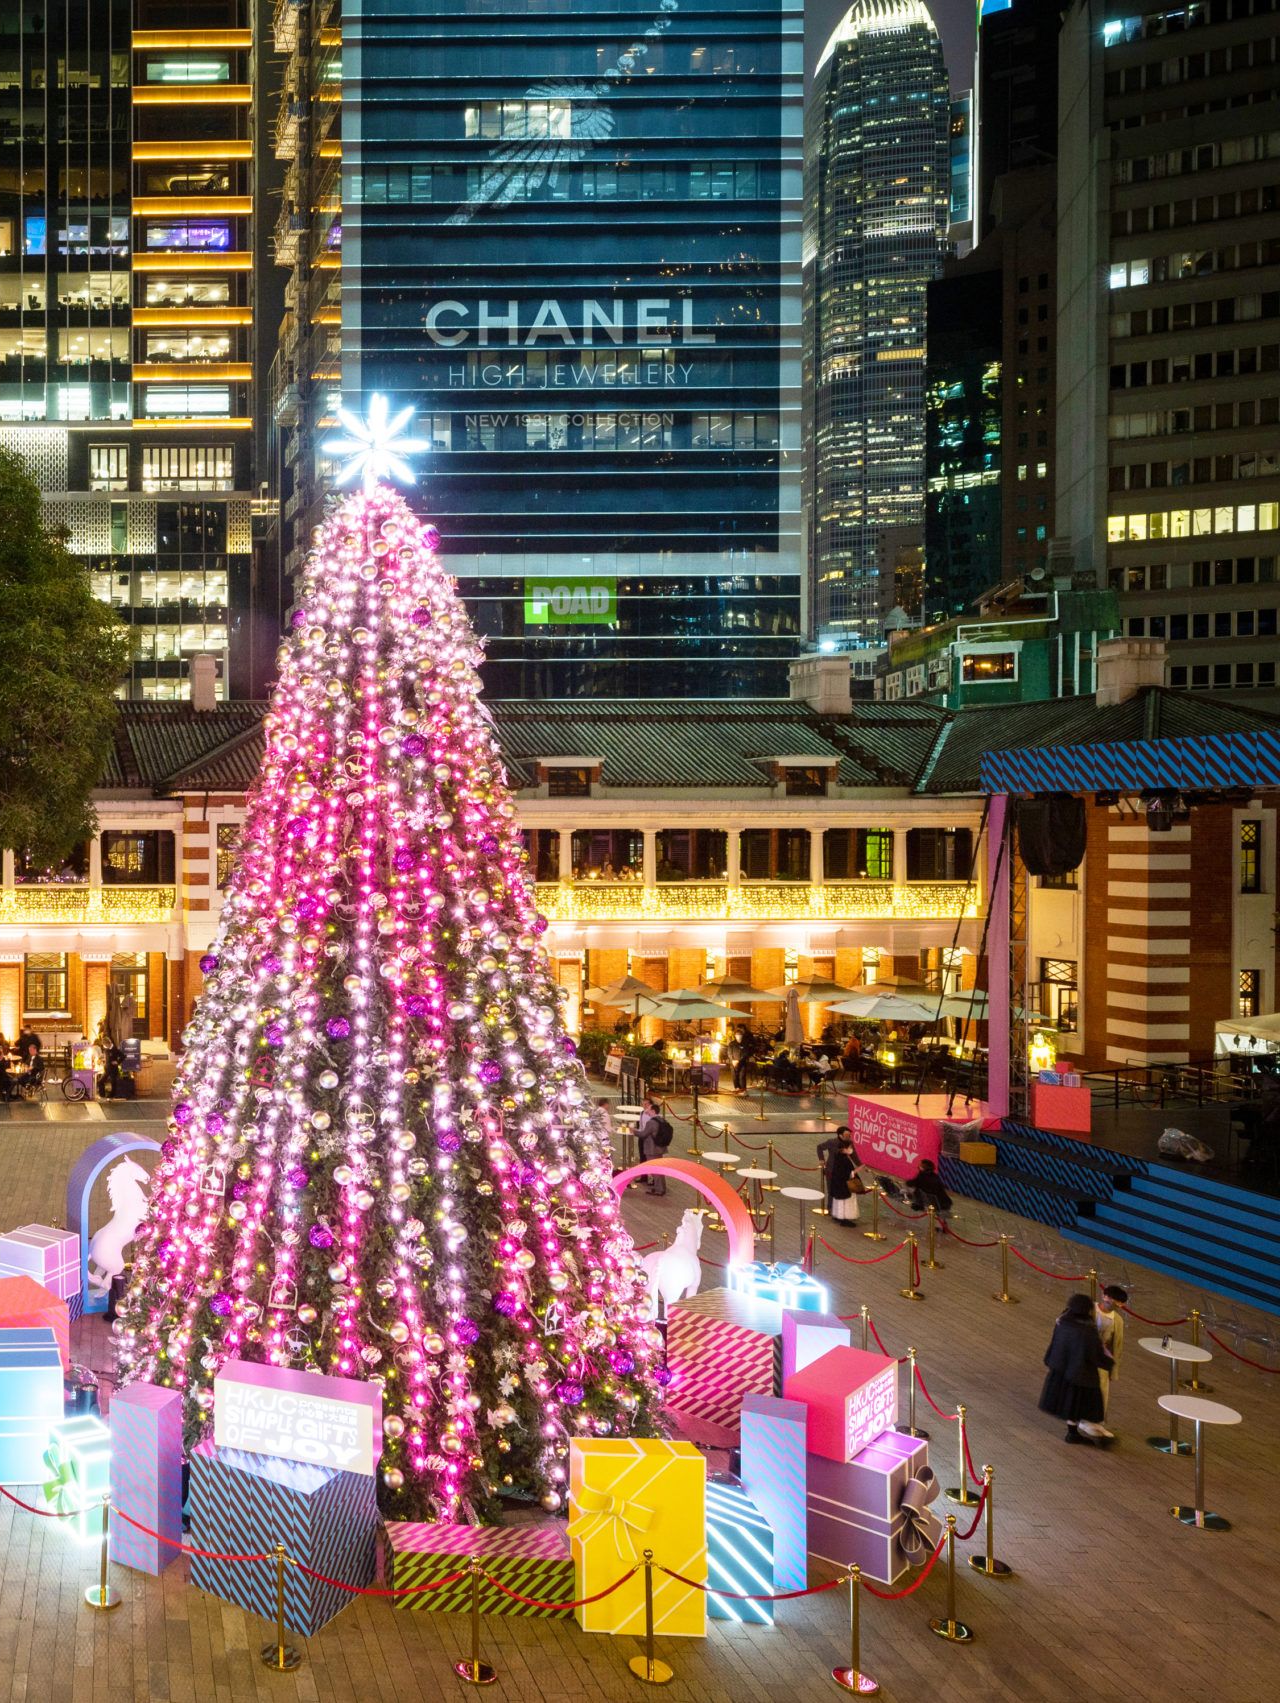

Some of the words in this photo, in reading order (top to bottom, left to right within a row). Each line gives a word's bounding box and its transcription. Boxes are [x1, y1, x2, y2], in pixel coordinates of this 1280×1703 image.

[425, 299, 716, 347] CHANEL
[449, 365, 525, 386] HIGH
[539, 363, 695, 388] JEWELLERY
[465, 413, 509, 427] NEW
[515, 413, 553, 427] 1932
[560, 412, 675, 427] COLLECTION
[532, 586, 611, 615] POAD
[853, 1103, 889, 1126] HKJC
[853, 1117, 886, 1140] SIMPLE
[887, 1129, 918, 1151] GIFTS
[853, 1131, 871, 1144] OF
[871, 1139, 920, 1164] JOY
[224, 1386, 298, 1415] HKJC
[848, 1382, 875, 1417] HKJC
[848, 1400, 874, 1434] SIMPLE
[873, 1387, 895, 1414] GIFTS
[224, 1404, 293, 1434] SIMPLE
[295, 1418, 358, 1446] GIFTS
[848, 1428, 863, 1454] OF
[862, 1402, 895, 1443] JOY
[225, 1425, 262, 1444] OF
[264, 1435, 362, 1465] JOY
